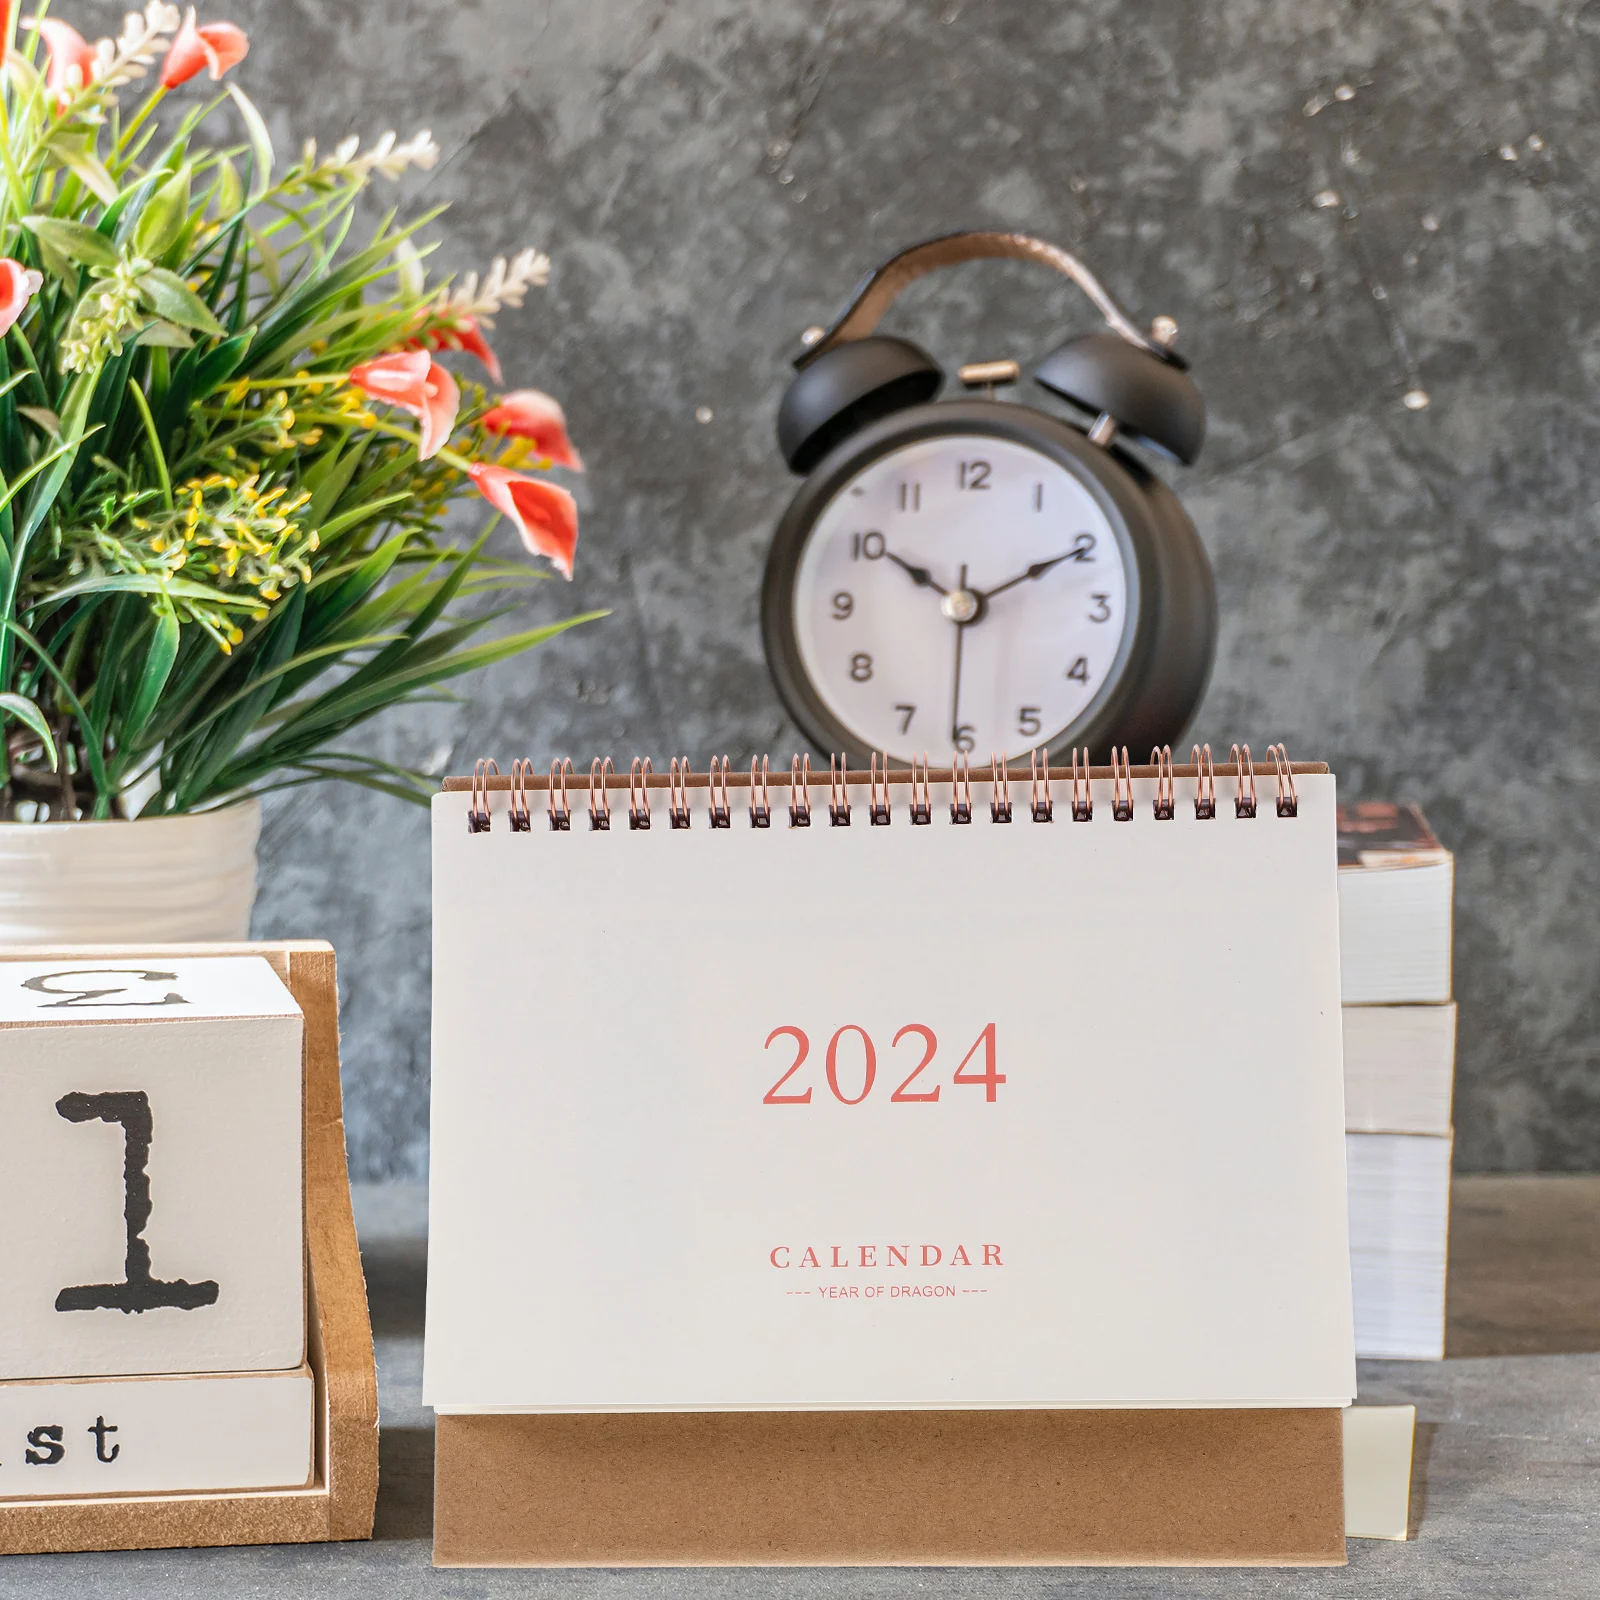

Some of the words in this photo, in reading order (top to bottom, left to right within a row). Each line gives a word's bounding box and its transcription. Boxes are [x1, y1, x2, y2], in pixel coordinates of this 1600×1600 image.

[960, 460, 991, 490] 12
[900, 482, 921, 512] 11
[1034, 483, 1043, 512] 1
[852, 531, 886, 561] 10
[1074, 533, 1096, 562] 2
[832, 592, 854, 621] 9
[1088, 594, 1110, 623] 3
[850, 653, 873, 683] 8
[1066, 656, 1090, 685] 4
[895, 705, 916, 735] 7
[1018, 707, 1041, 736] 5
[953, 725, 976, 754] 6
[763, 1022, 1006, 1105] 2024
[55, 1090, 219, 1314] 1
[769, 1244, 1004, 1269] CALENDAR
[818, 1286, 860, 1299] YEAR
[864, 1286, 885, 1298] OF
[890, 1285, 956, 1298] DRAGON
[10, 1415, 120, 1466] st
